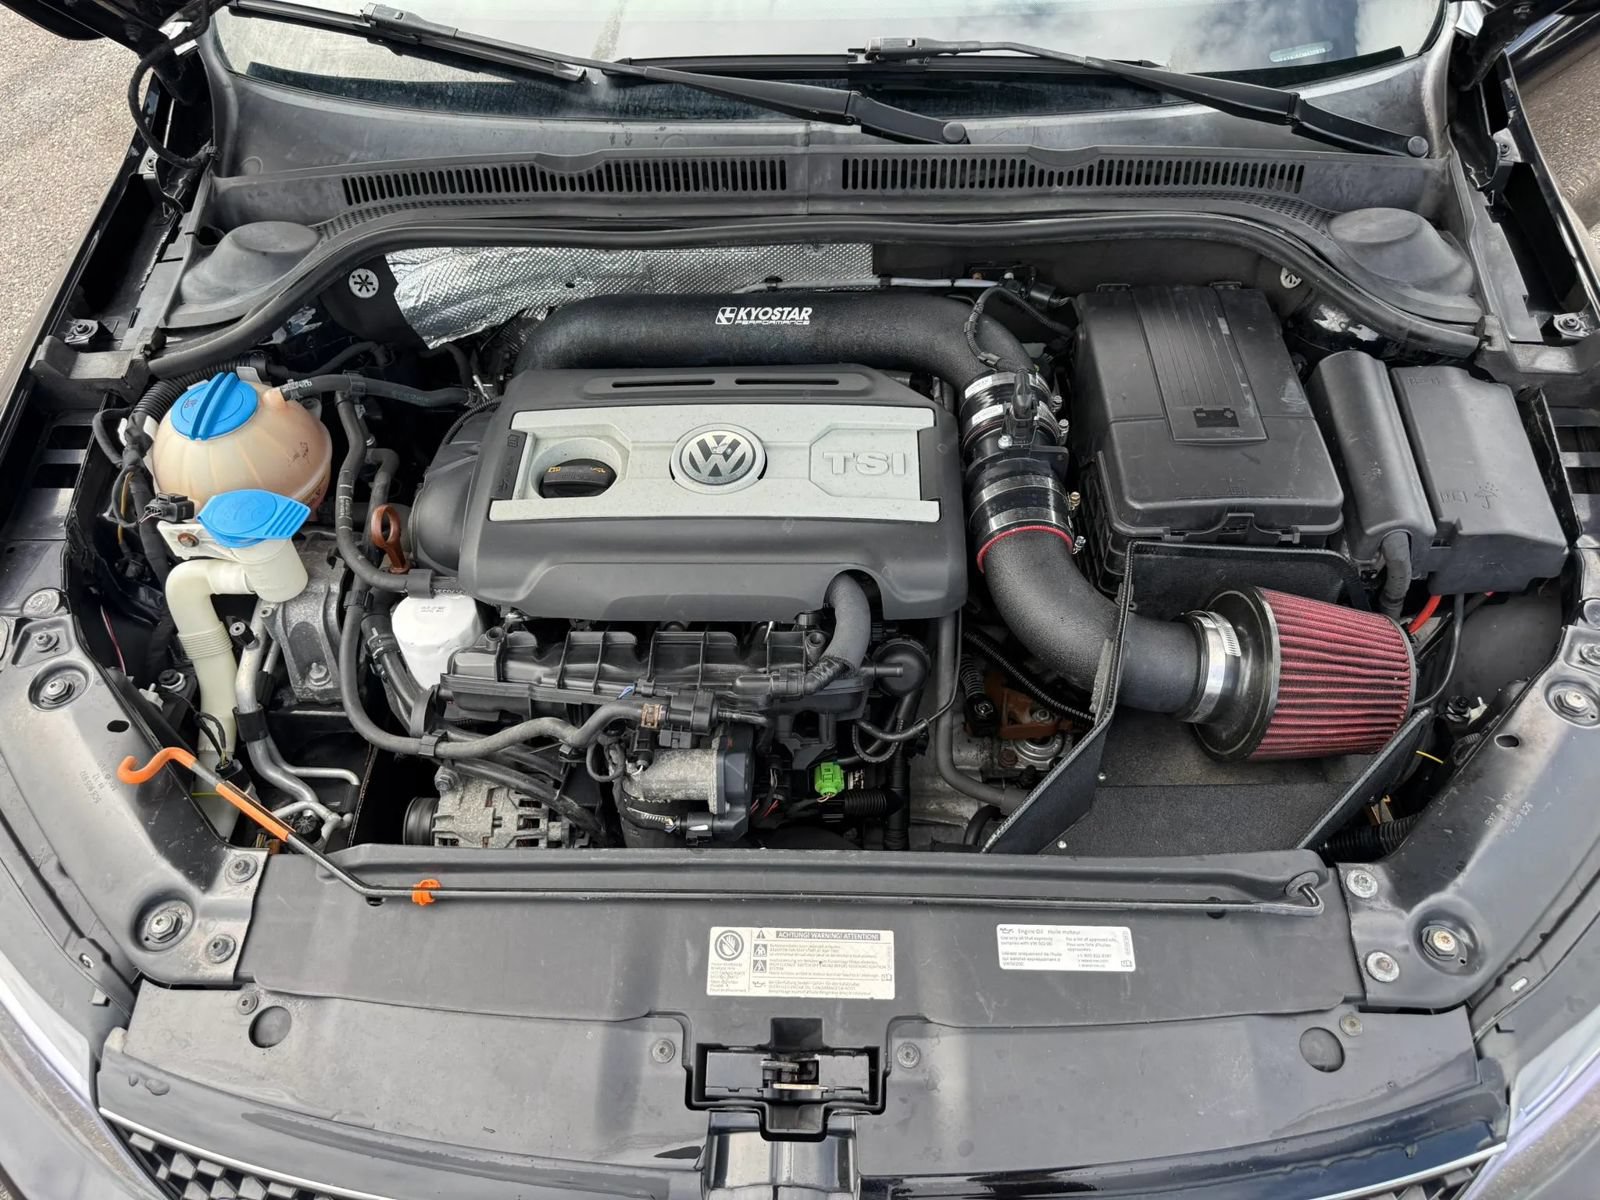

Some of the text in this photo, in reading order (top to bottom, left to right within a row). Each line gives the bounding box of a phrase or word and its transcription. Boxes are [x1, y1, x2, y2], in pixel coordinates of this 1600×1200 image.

[736, 307, 813, 320] KYOSTAR
[688, 433, 747, 478] VW
[823, 451, 906, 476] TSI
